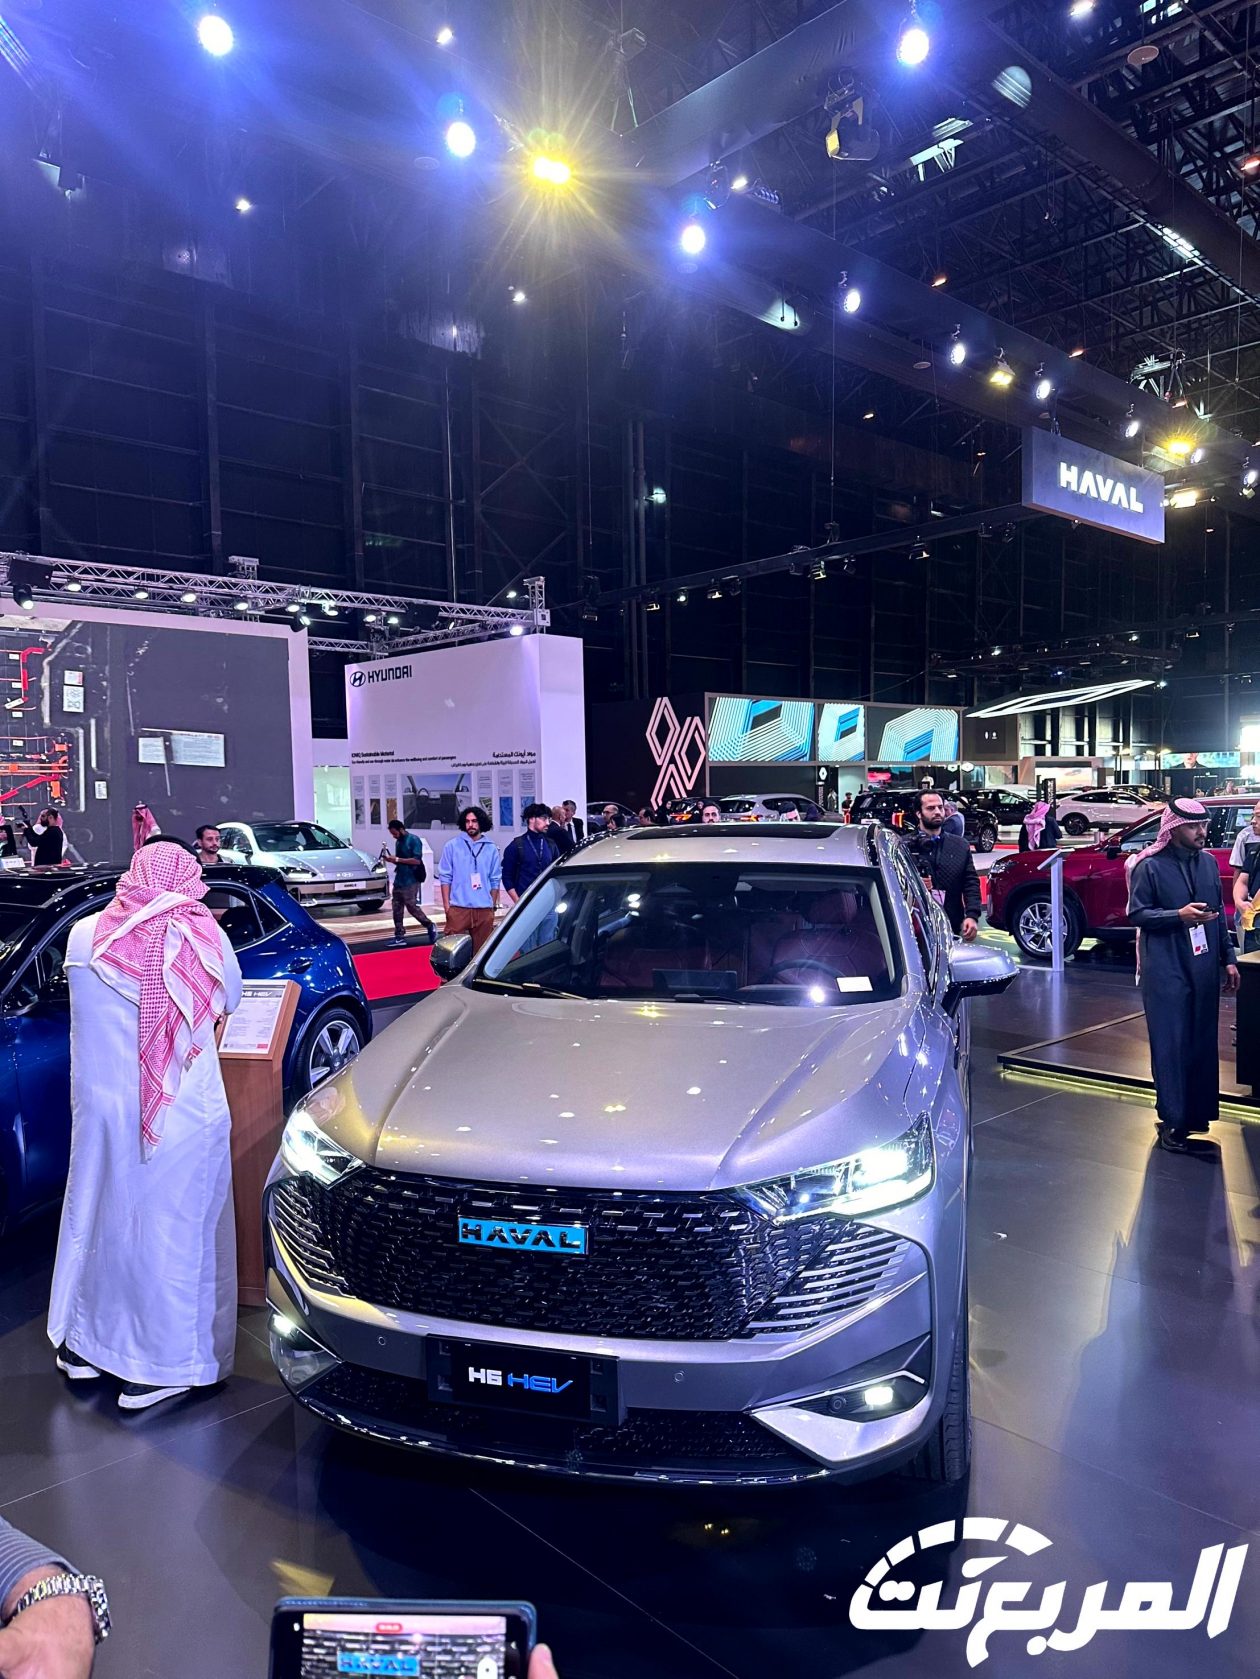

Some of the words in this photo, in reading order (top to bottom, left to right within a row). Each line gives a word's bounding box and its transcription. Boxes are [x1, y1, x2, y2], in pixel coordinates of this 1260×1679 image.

[1059, 461, 1144, 514] HAVAL
[367, 664, 413, 684] HYUNDAI
[461, 1222, 581, 1249] HAVAL
[468, 1366, 502, 1386] H6
[507, 1371, 574, 1393] HEV
[340, 1656, 414, 1672] HAVAL
